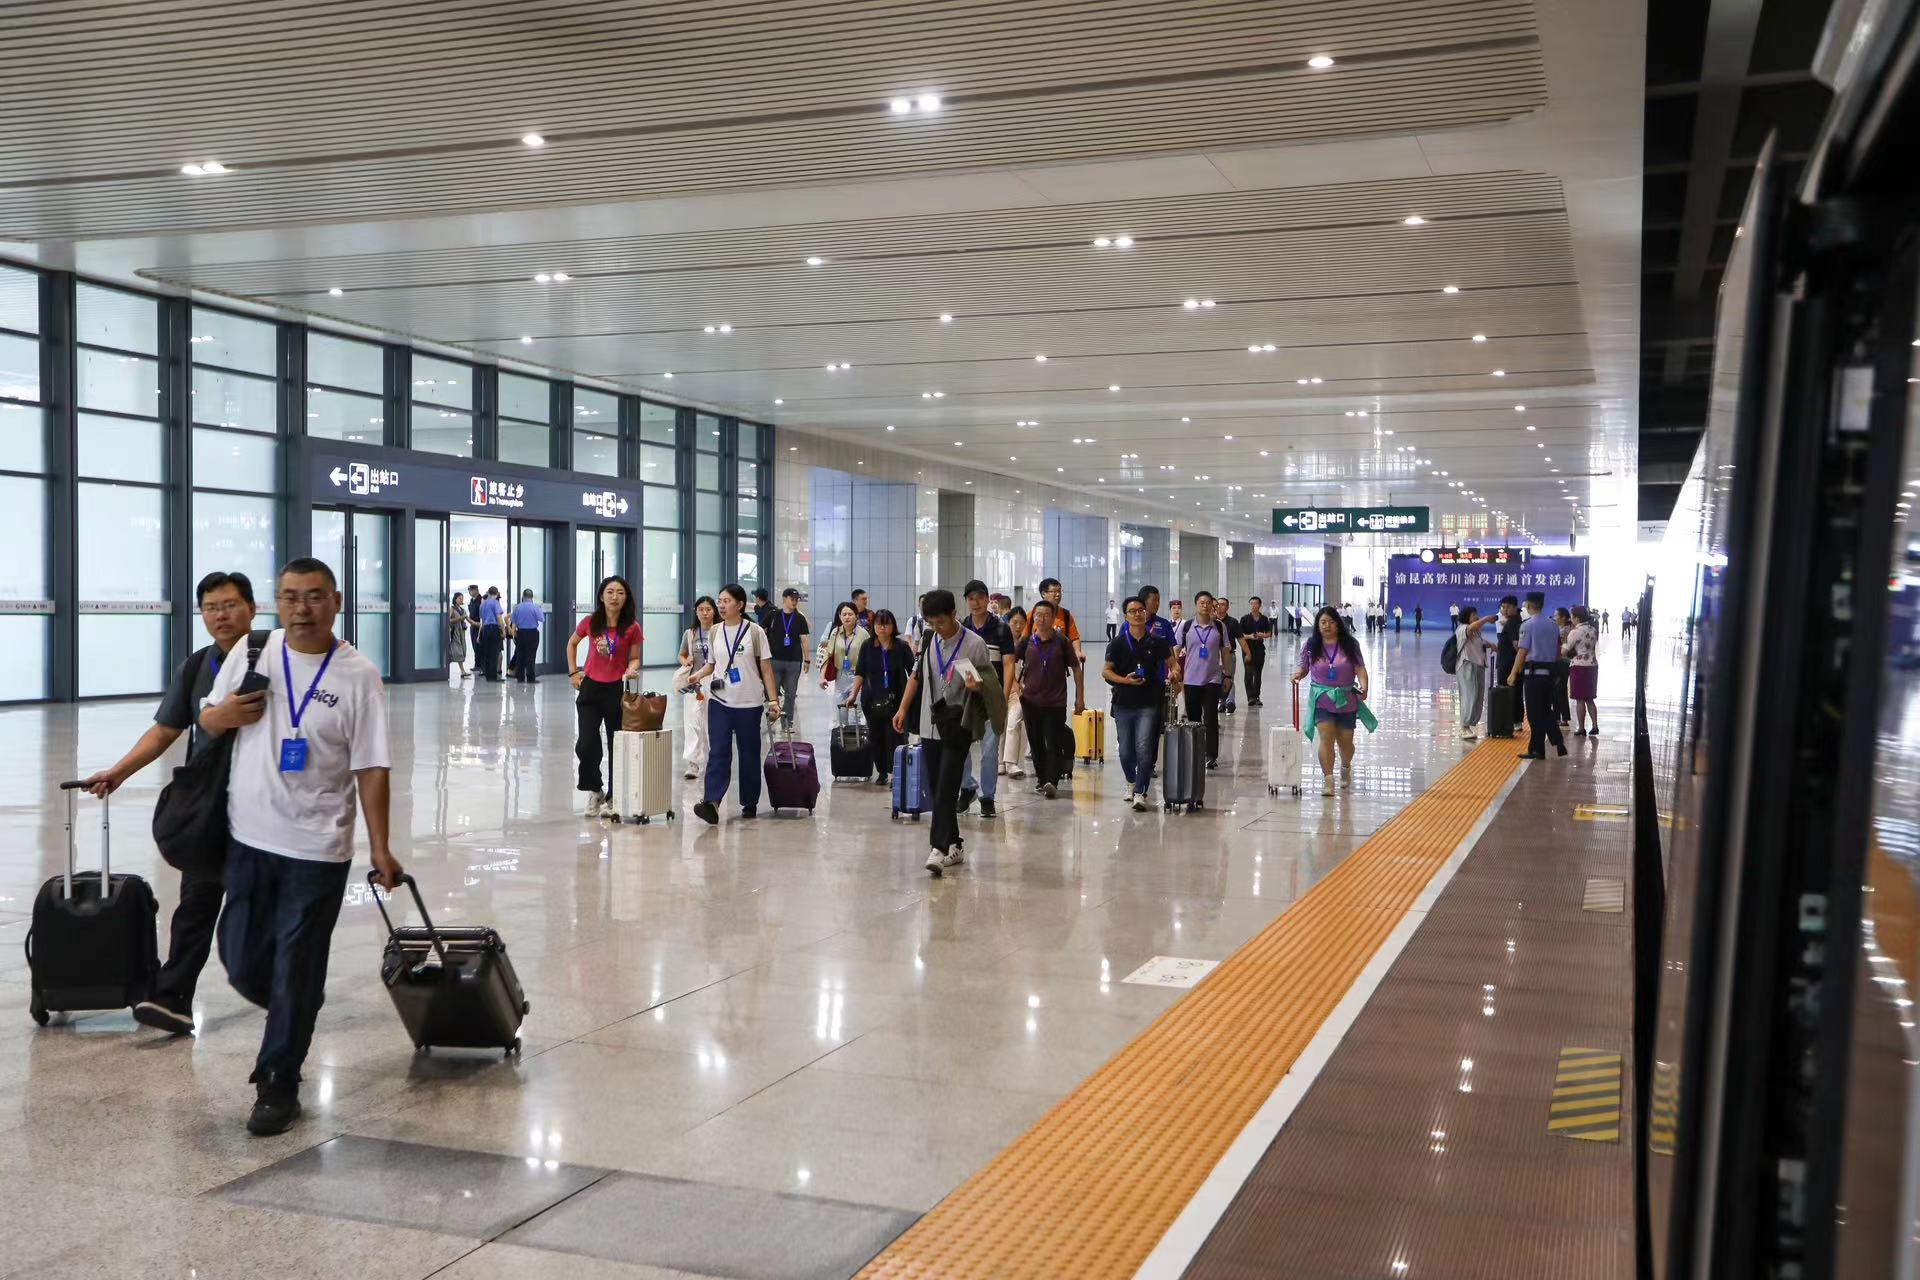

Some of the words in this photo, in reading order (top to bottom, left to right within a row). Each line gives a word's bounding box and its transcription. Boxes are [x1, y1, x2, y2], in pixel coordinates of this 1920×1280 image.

[370, 468, 399, 486] 出站口
[1394, 572, 1576, 586] 渝昆高铁川渝段开通首发活动
